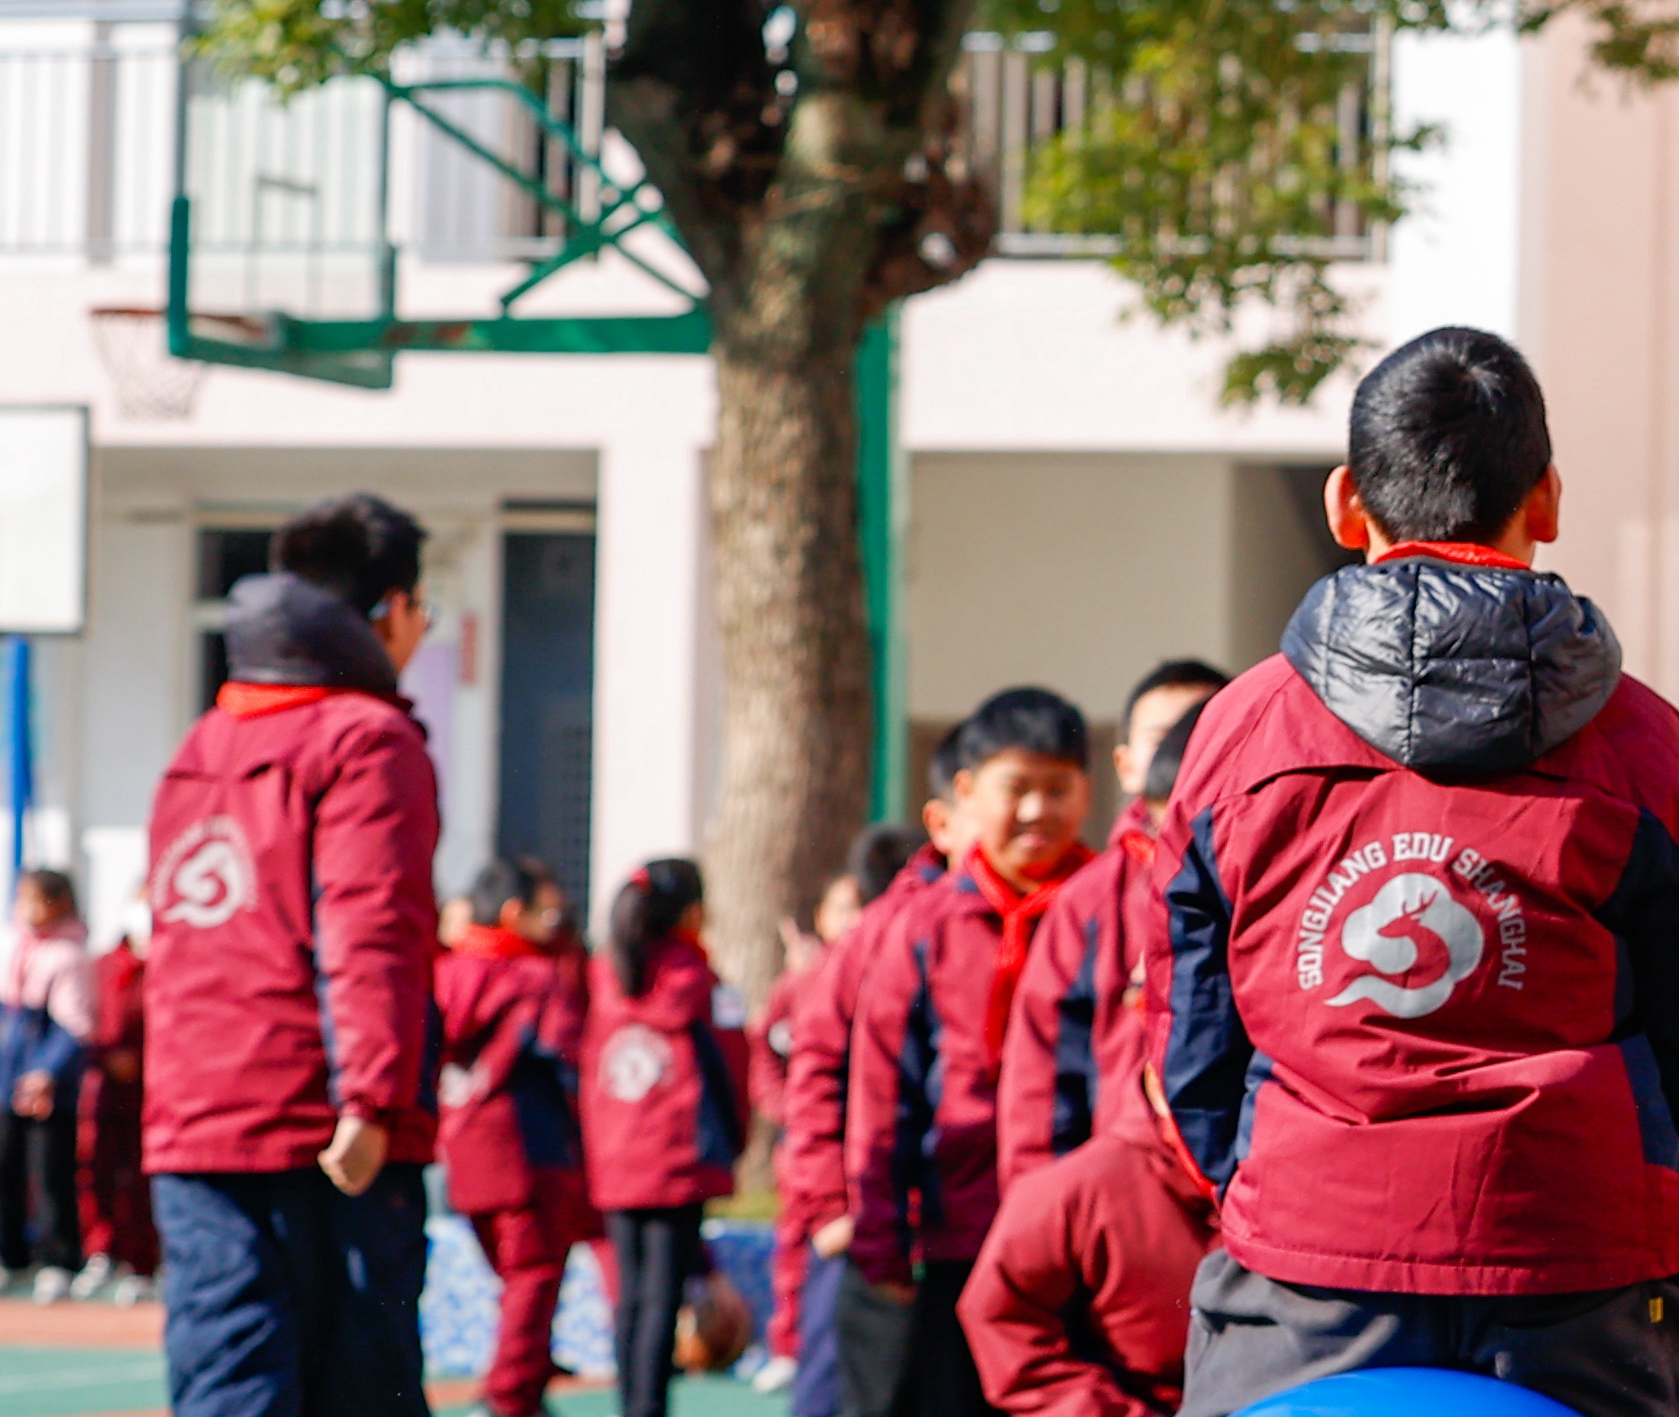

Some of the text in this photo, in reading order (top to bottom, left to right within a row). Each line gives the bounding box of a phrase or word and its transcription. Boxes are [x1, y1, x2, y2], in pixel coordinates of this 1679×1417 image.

[1297, 832, 1527, 991] SONGJIANG EDU SHANGHAI
